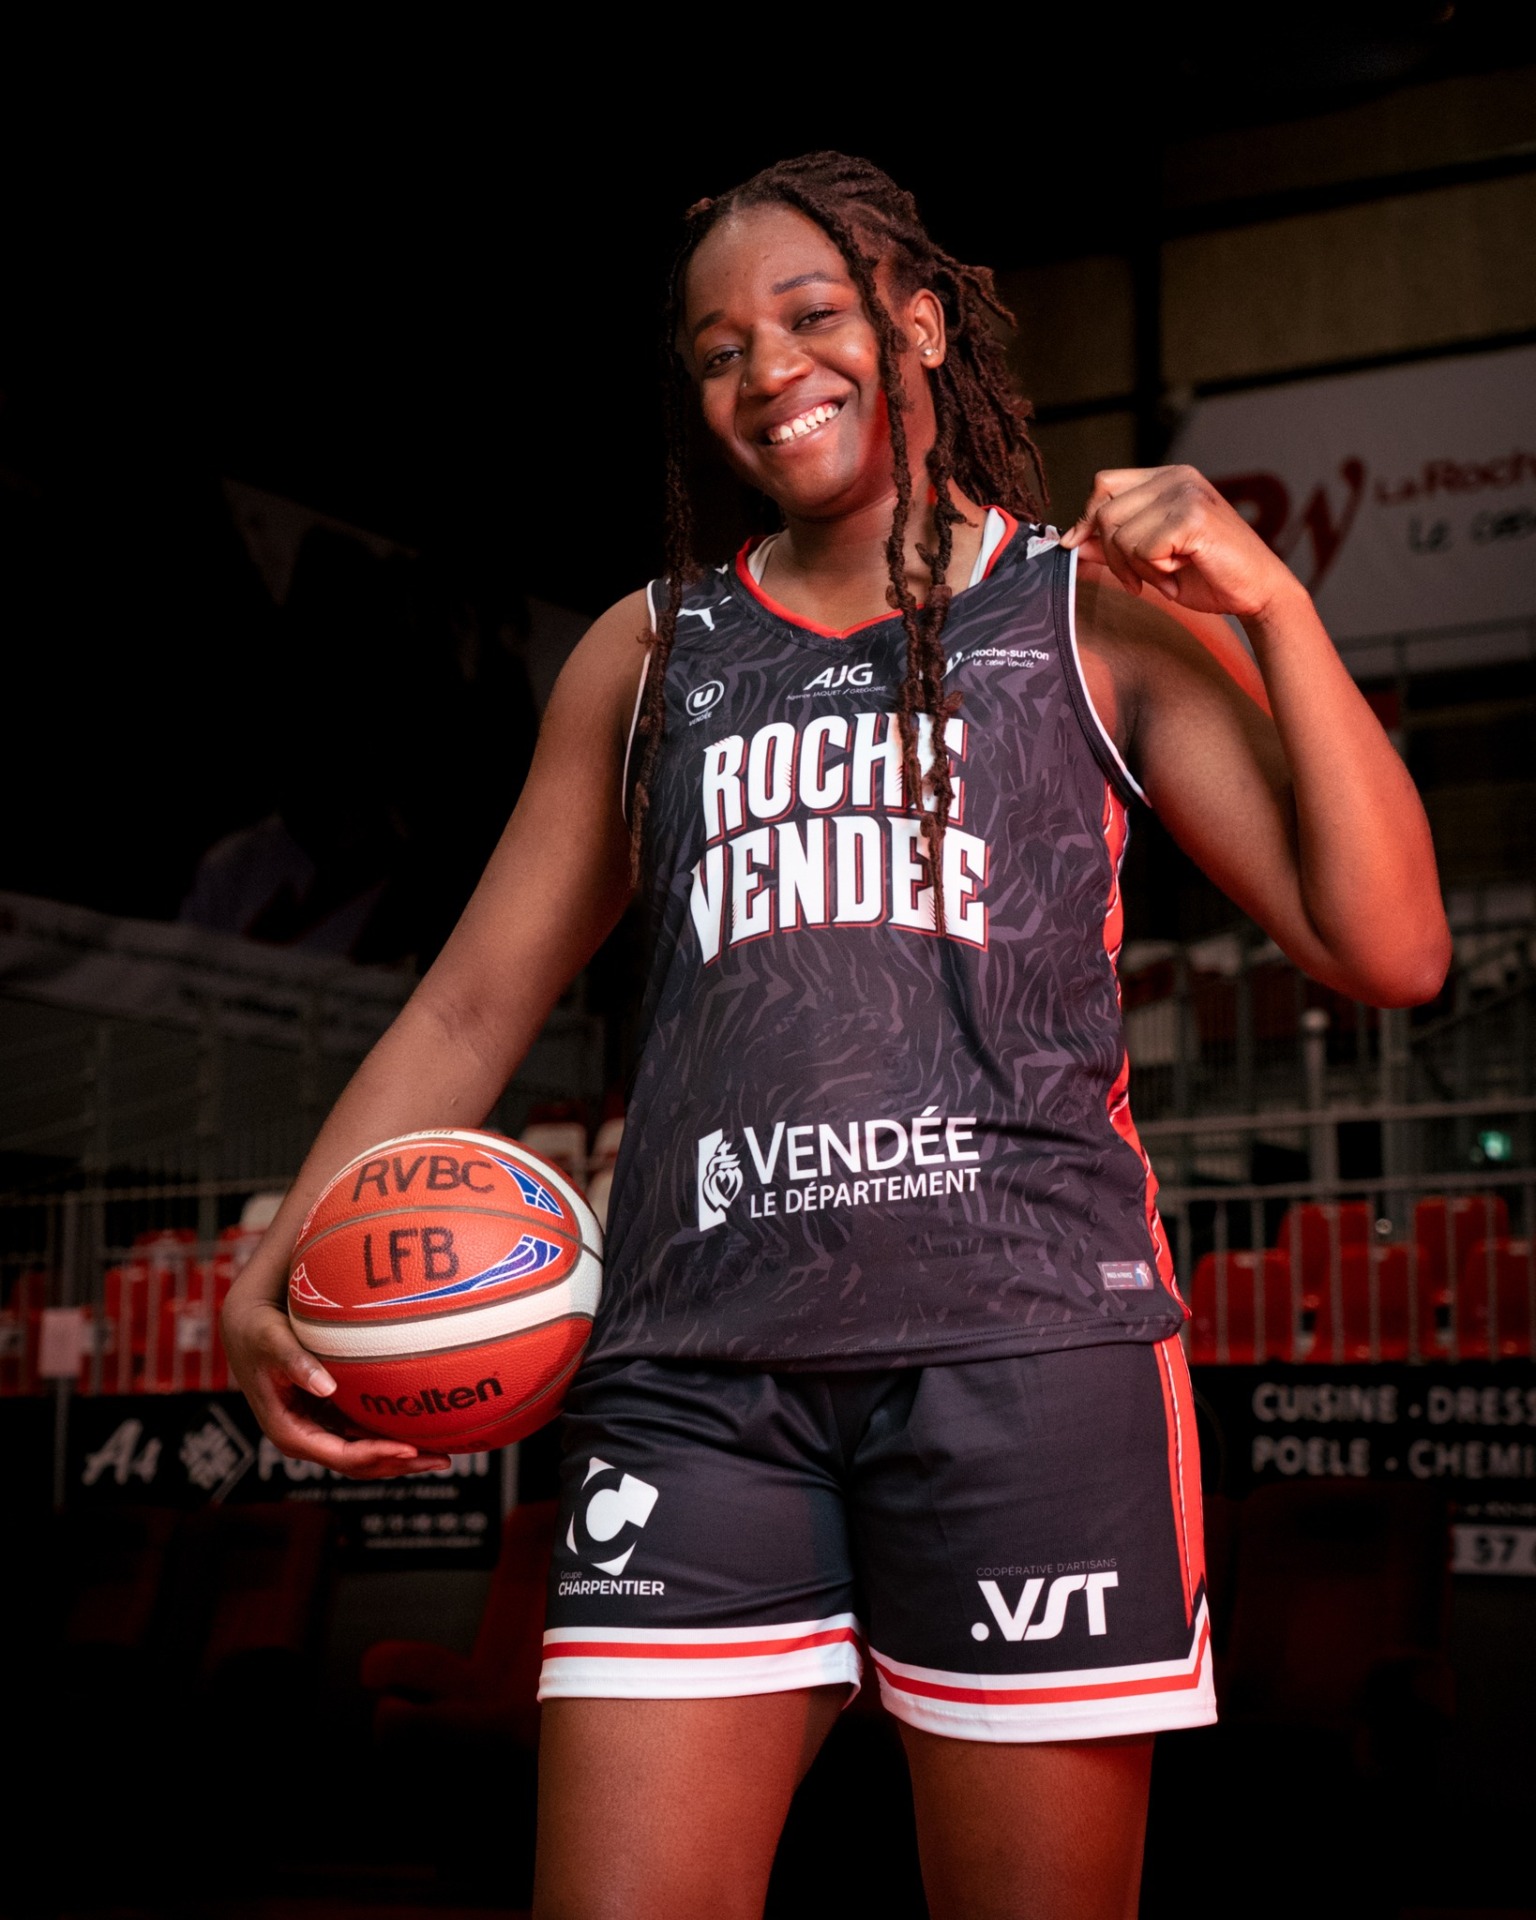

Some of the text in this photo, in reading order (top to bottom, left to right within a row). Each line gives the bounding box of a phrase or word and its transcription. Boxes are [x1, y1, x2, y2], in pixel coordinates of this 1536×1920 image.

[803, 662, 873, 691] AJG
[702, 711, 968, 846] ROCHE
[690, 814, 990, 967] VENDEE
[743, 1106, 980, 1185] VENDÉE
[351, 1154, 496, 1203] RVBC
[750, 1167, 981, 1219] LE DÉPARTEMENT
[362, 1226, 460, 1289] LFB
[360, 1376, 504, 1417] molten
[1252, 1382, 1398, 1423] CUISINE
[558, 1580, 665, 1596] CHARPENTIER
[976, 1558, 1117, 1577] COOPÉRATIVE D'ARTISANS
